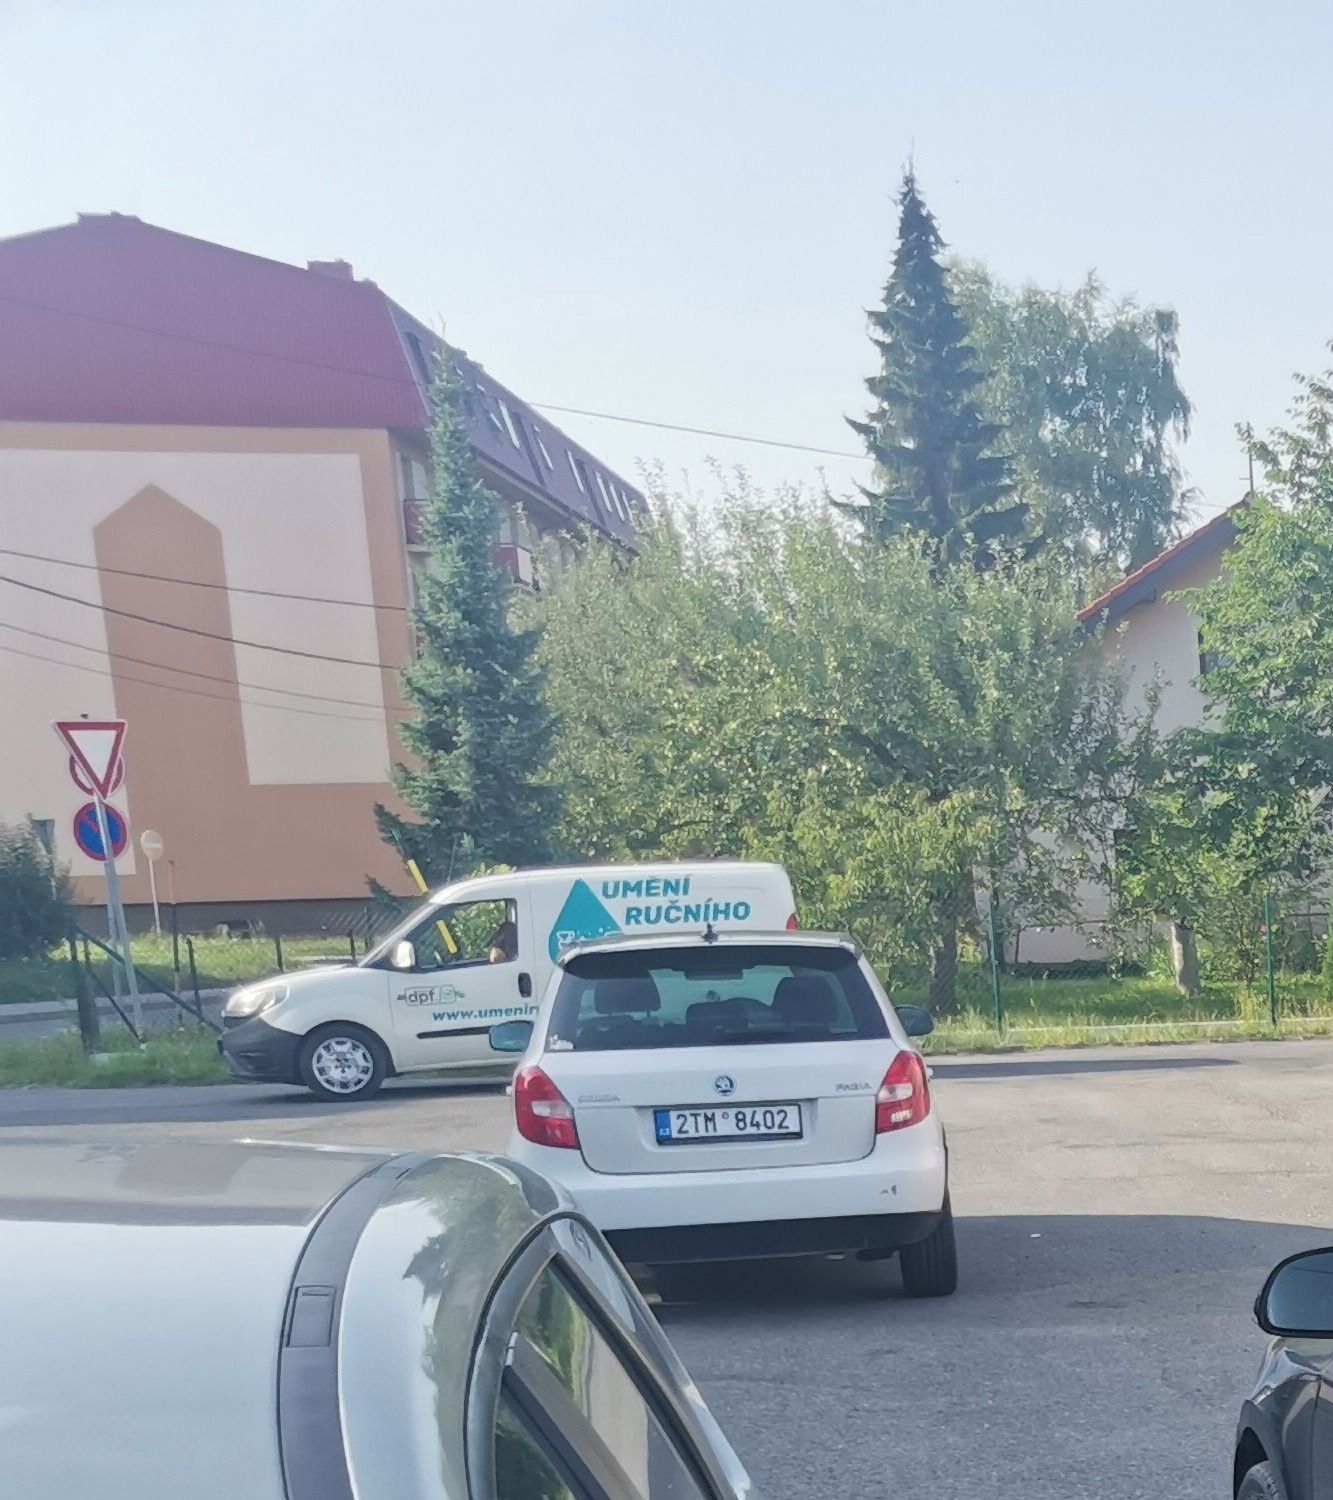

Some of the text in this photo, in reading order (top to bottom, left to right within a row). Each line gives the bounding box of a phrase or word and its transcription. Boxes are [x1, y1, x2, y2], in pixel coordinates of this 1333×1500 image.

[601, 874, 692, 899] UMĚNÍ
[625, 898, 751, 926] RUČNÍHO
[408, 990, 435, 1005] dpf
[676, 1109, 790, 1135] 2TM 8402
